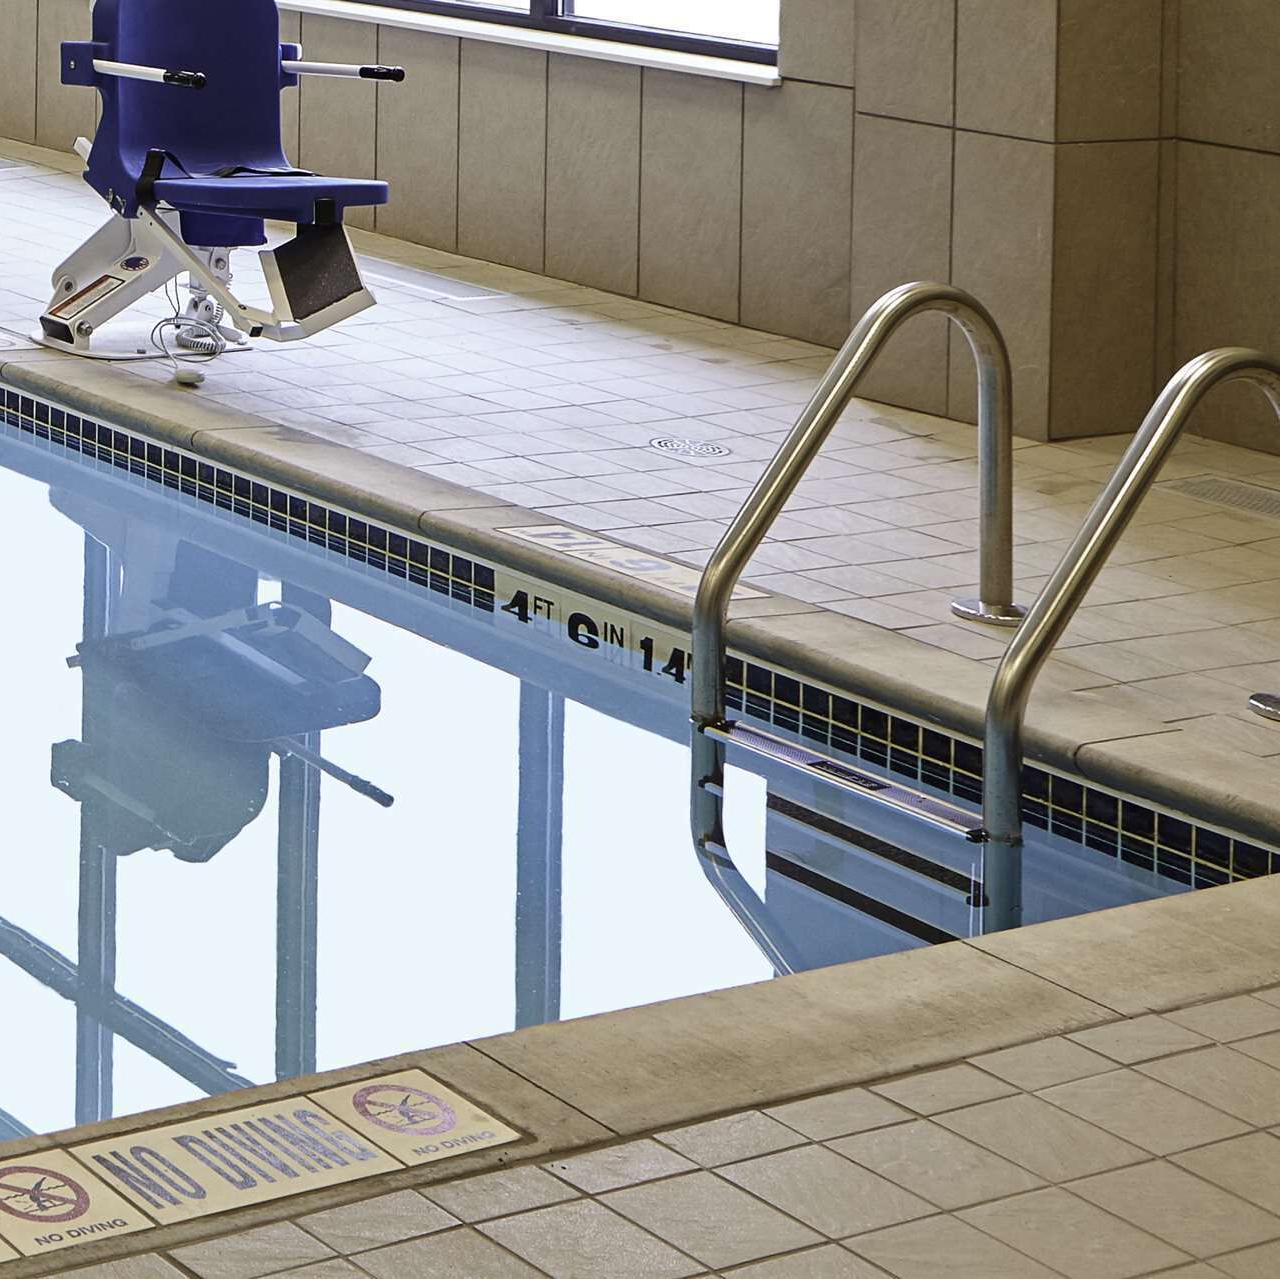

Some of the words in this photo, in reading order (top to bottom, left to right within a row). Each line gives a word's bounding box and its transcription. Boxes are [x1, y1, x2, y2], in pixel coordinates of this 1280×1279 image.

[501, 590, 533, 624] 4
[533, 596, 554, 620] FT
[568, 612, 600, 649] 6
[603, 622, 625, 648] IN
[91, 1145, 208, 1210] NO
[172, 1109, 379, 1190] DIVING
[412, 1144, 439, 1156] NO
[441, 1130, 496, 1149] DIVING
[34, 1233, 63, 1246] NO
[67, 1218, 129, 1238] DIVING
